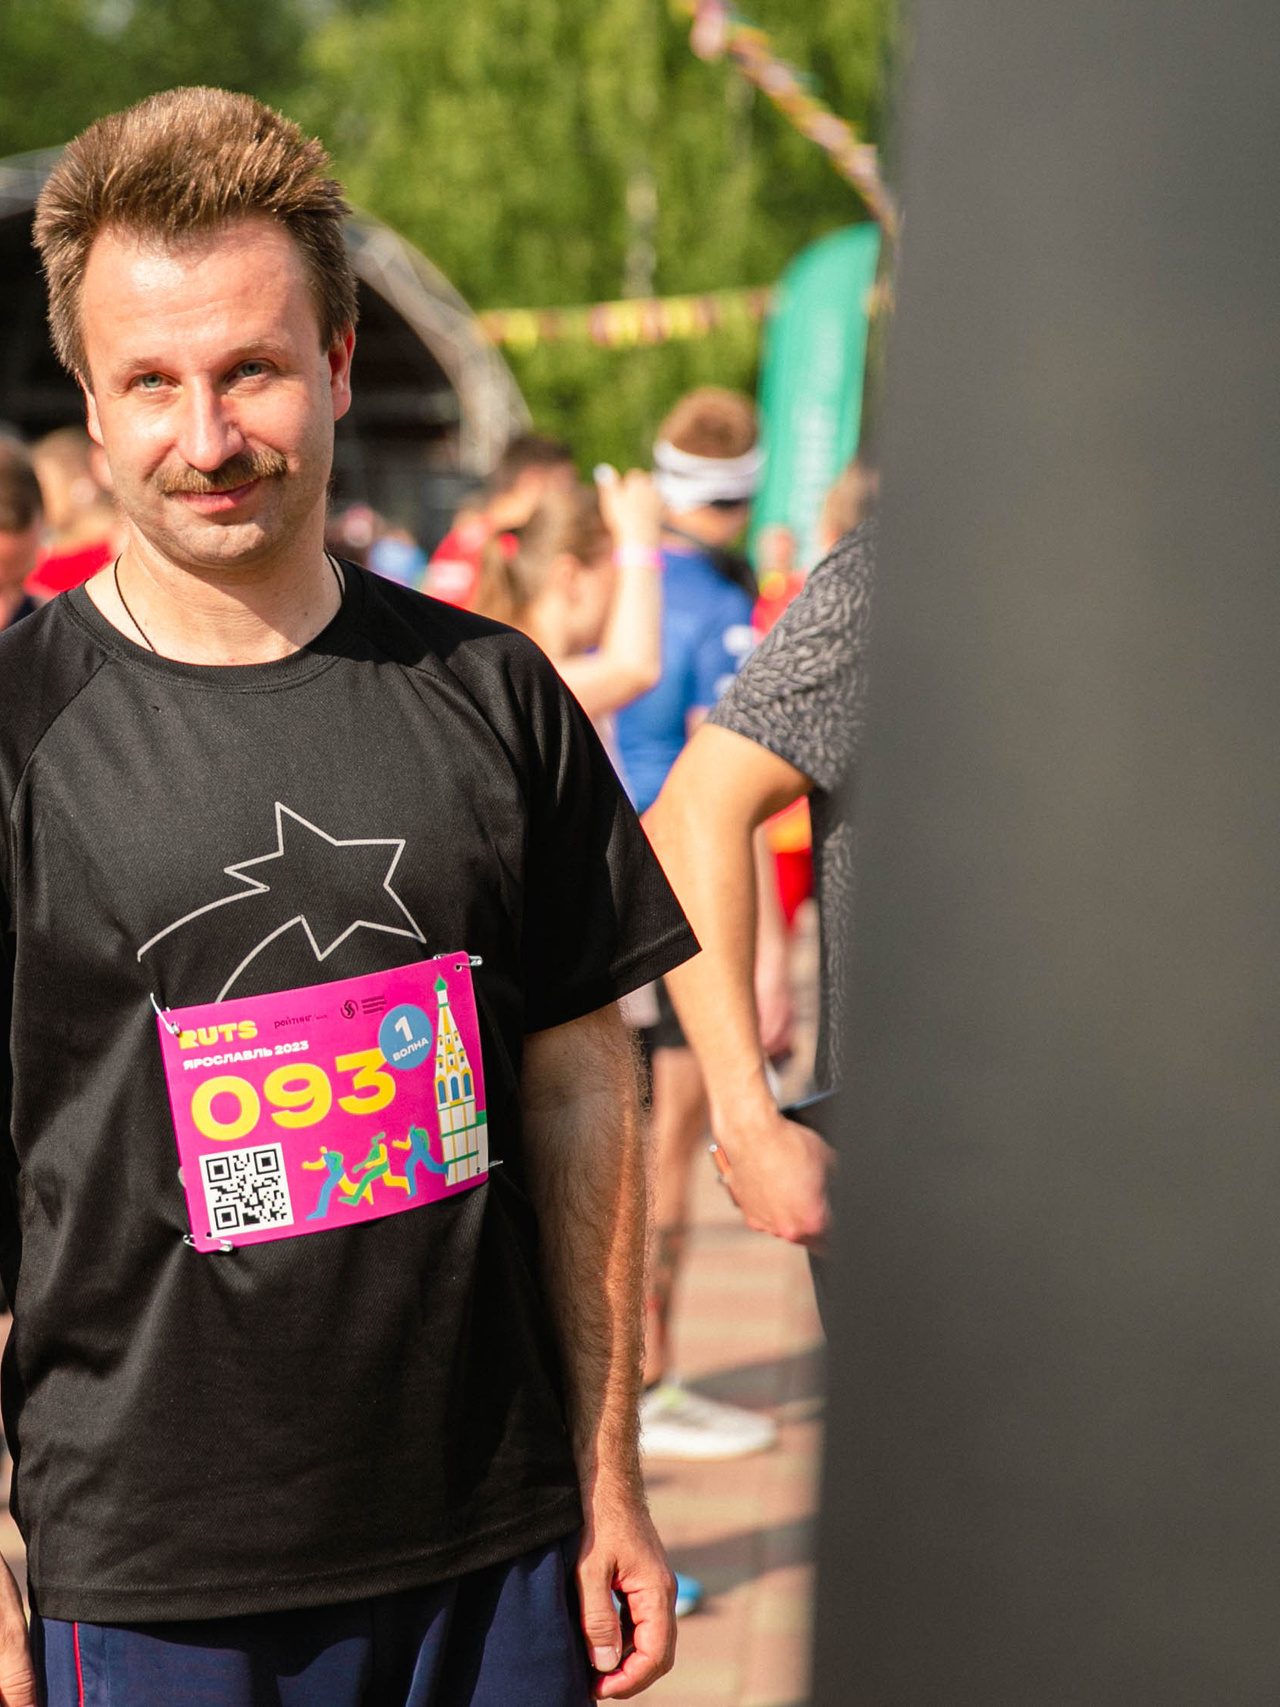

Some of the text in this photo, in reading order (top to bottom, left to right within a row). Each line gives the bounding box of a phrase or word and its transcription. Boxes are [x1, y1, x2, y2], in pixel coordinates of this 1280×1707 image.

[180, 1020, 258, 1050] RUTS
[394, 1015, 414, 1042] 1
[183, 1040, 309, 1071] ЯРОСЛАВЛЬ 2023
[392, 1037, 429, 1062] ВОЛНА
[191, 1048, 396, 1141] 093
